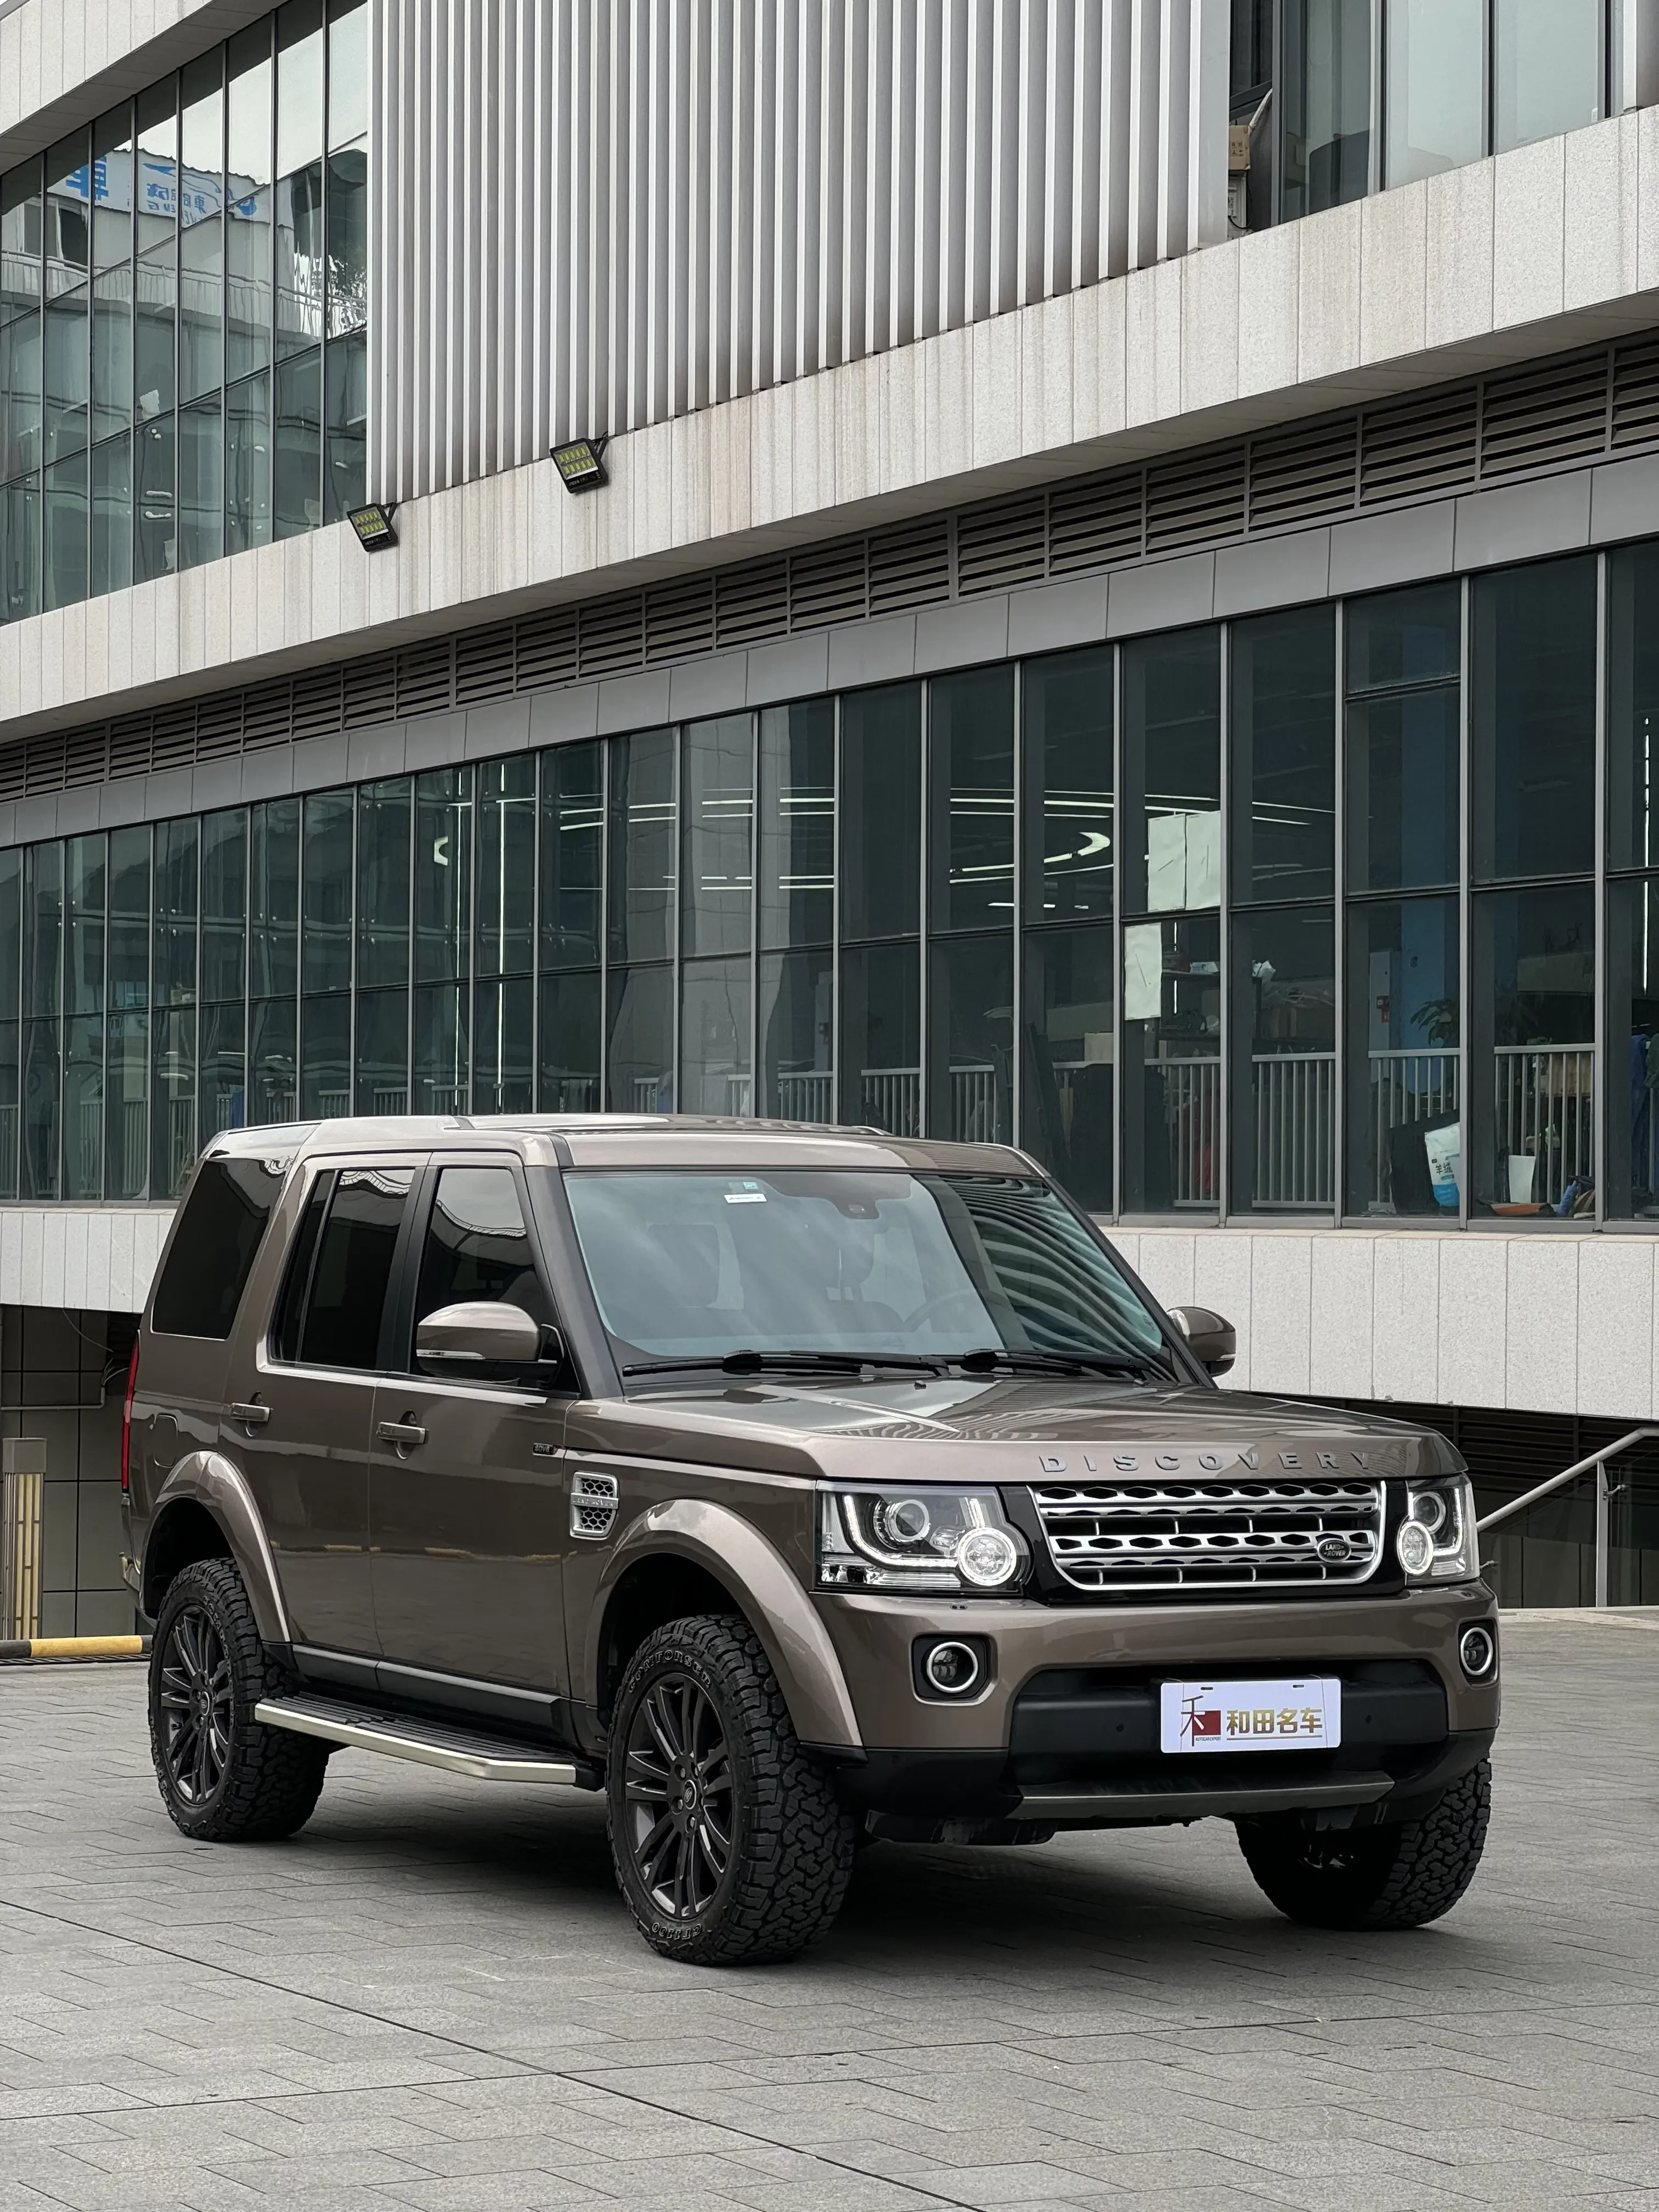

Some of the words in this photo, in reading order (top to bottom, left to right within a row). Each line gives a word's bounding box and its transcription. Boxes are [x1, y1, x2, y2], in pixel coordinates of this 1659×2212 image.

[1039, 1451, 1372, 1472] DISCOVERY
[628, 1649, 712, 1694] COMFORSER
[1226, 1707, 1323, 1736] 和田名车
